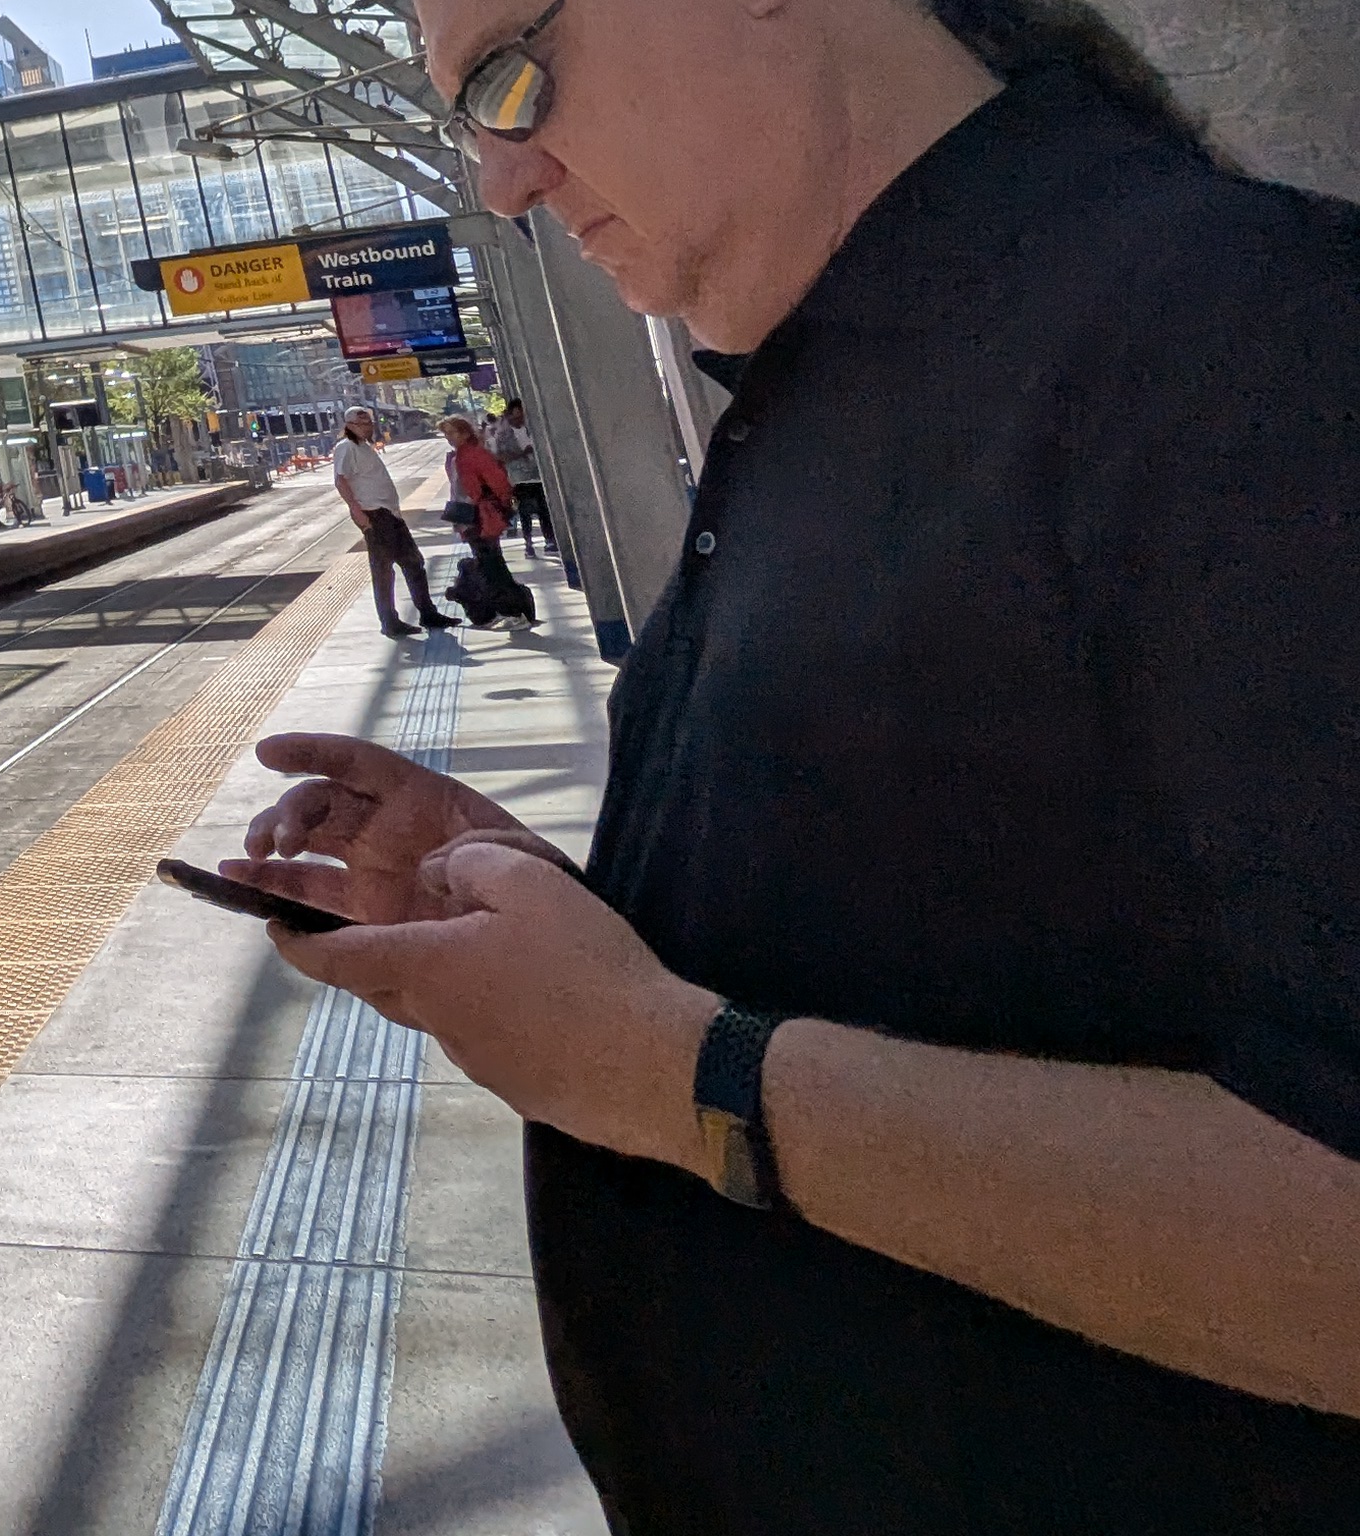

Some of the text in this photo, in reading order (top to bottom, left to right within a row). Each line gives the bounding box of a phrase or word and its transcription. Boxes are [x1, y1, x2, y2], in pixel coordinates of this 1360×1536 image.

[317, 240, 436, 270] Westbound
[210, 256, 285, 278] DANGER
[321, 271, 374, 290] Train
